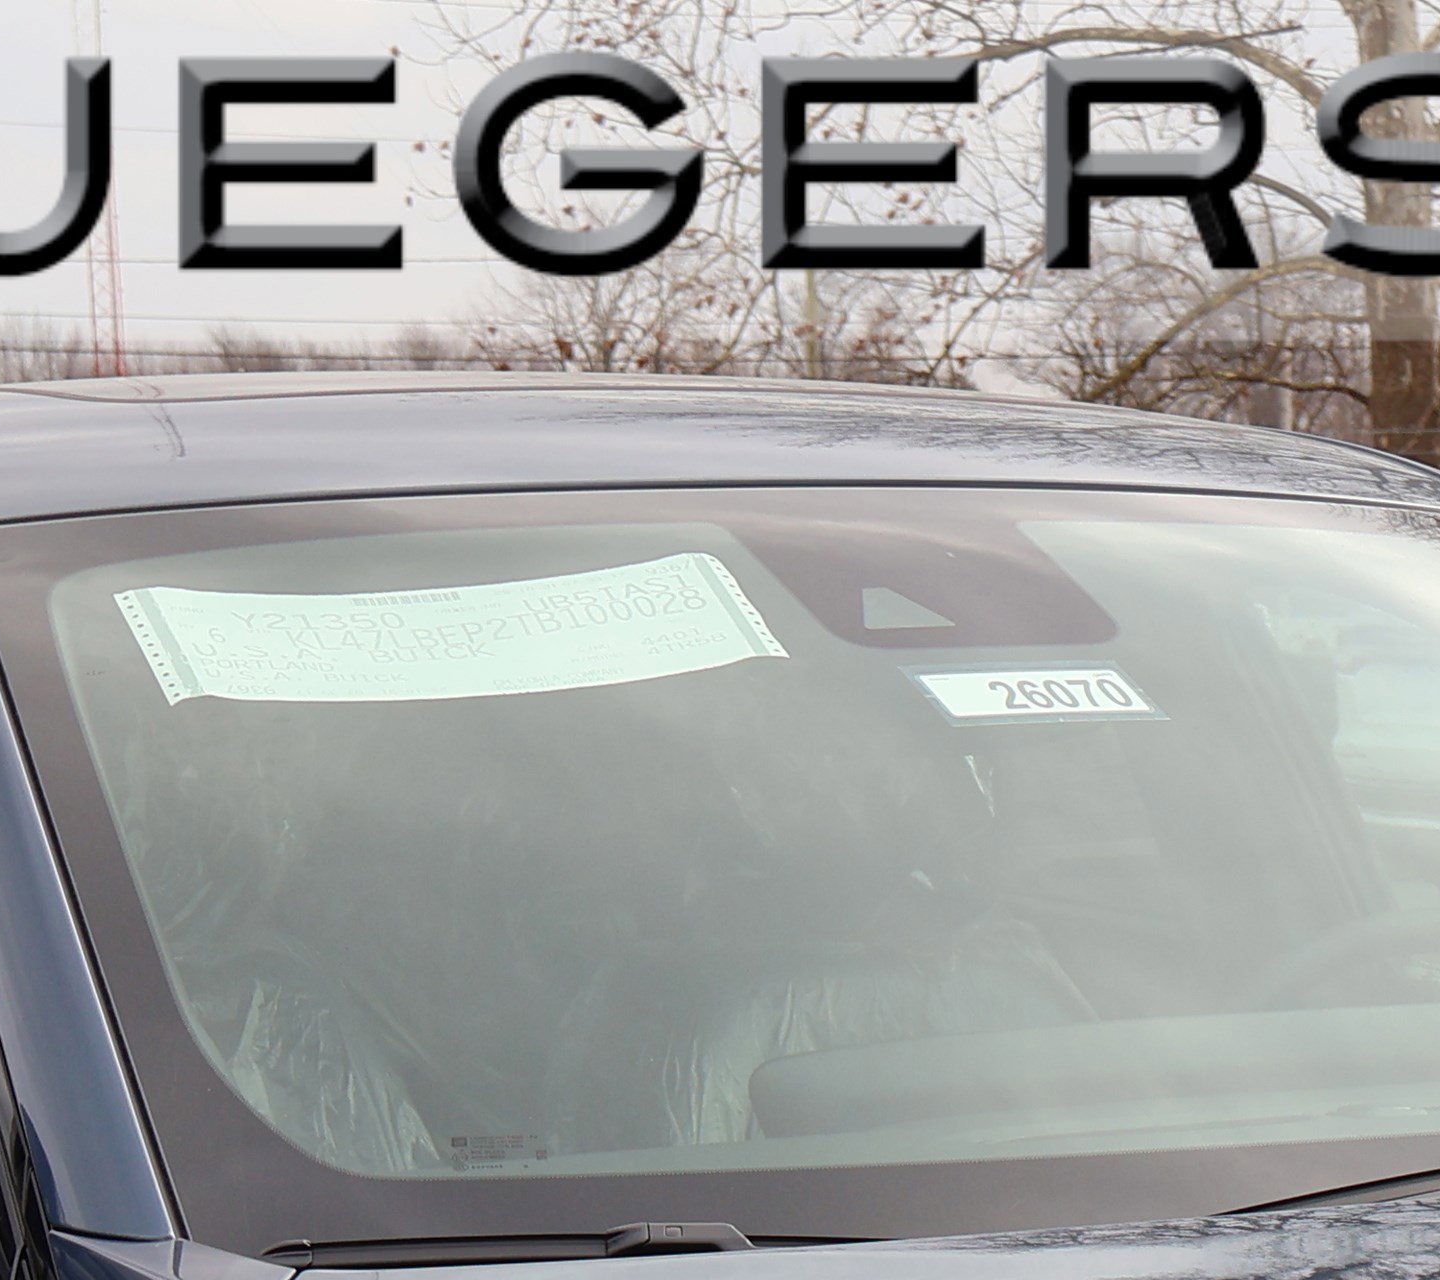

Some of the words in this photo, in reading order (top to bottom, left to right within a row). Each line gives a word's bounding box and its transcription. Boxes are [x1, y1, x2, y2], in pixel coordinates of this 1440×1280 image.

[230, 611, 406, 630] Y21350
[208, 627, 226, 642] 6
[368, 641, 497, 663] BUICK
[201, 659, 335, 672] PORTLAND
[324, 673, 407, 682] BUICK
[988, 679, 1133, 709] 26070
